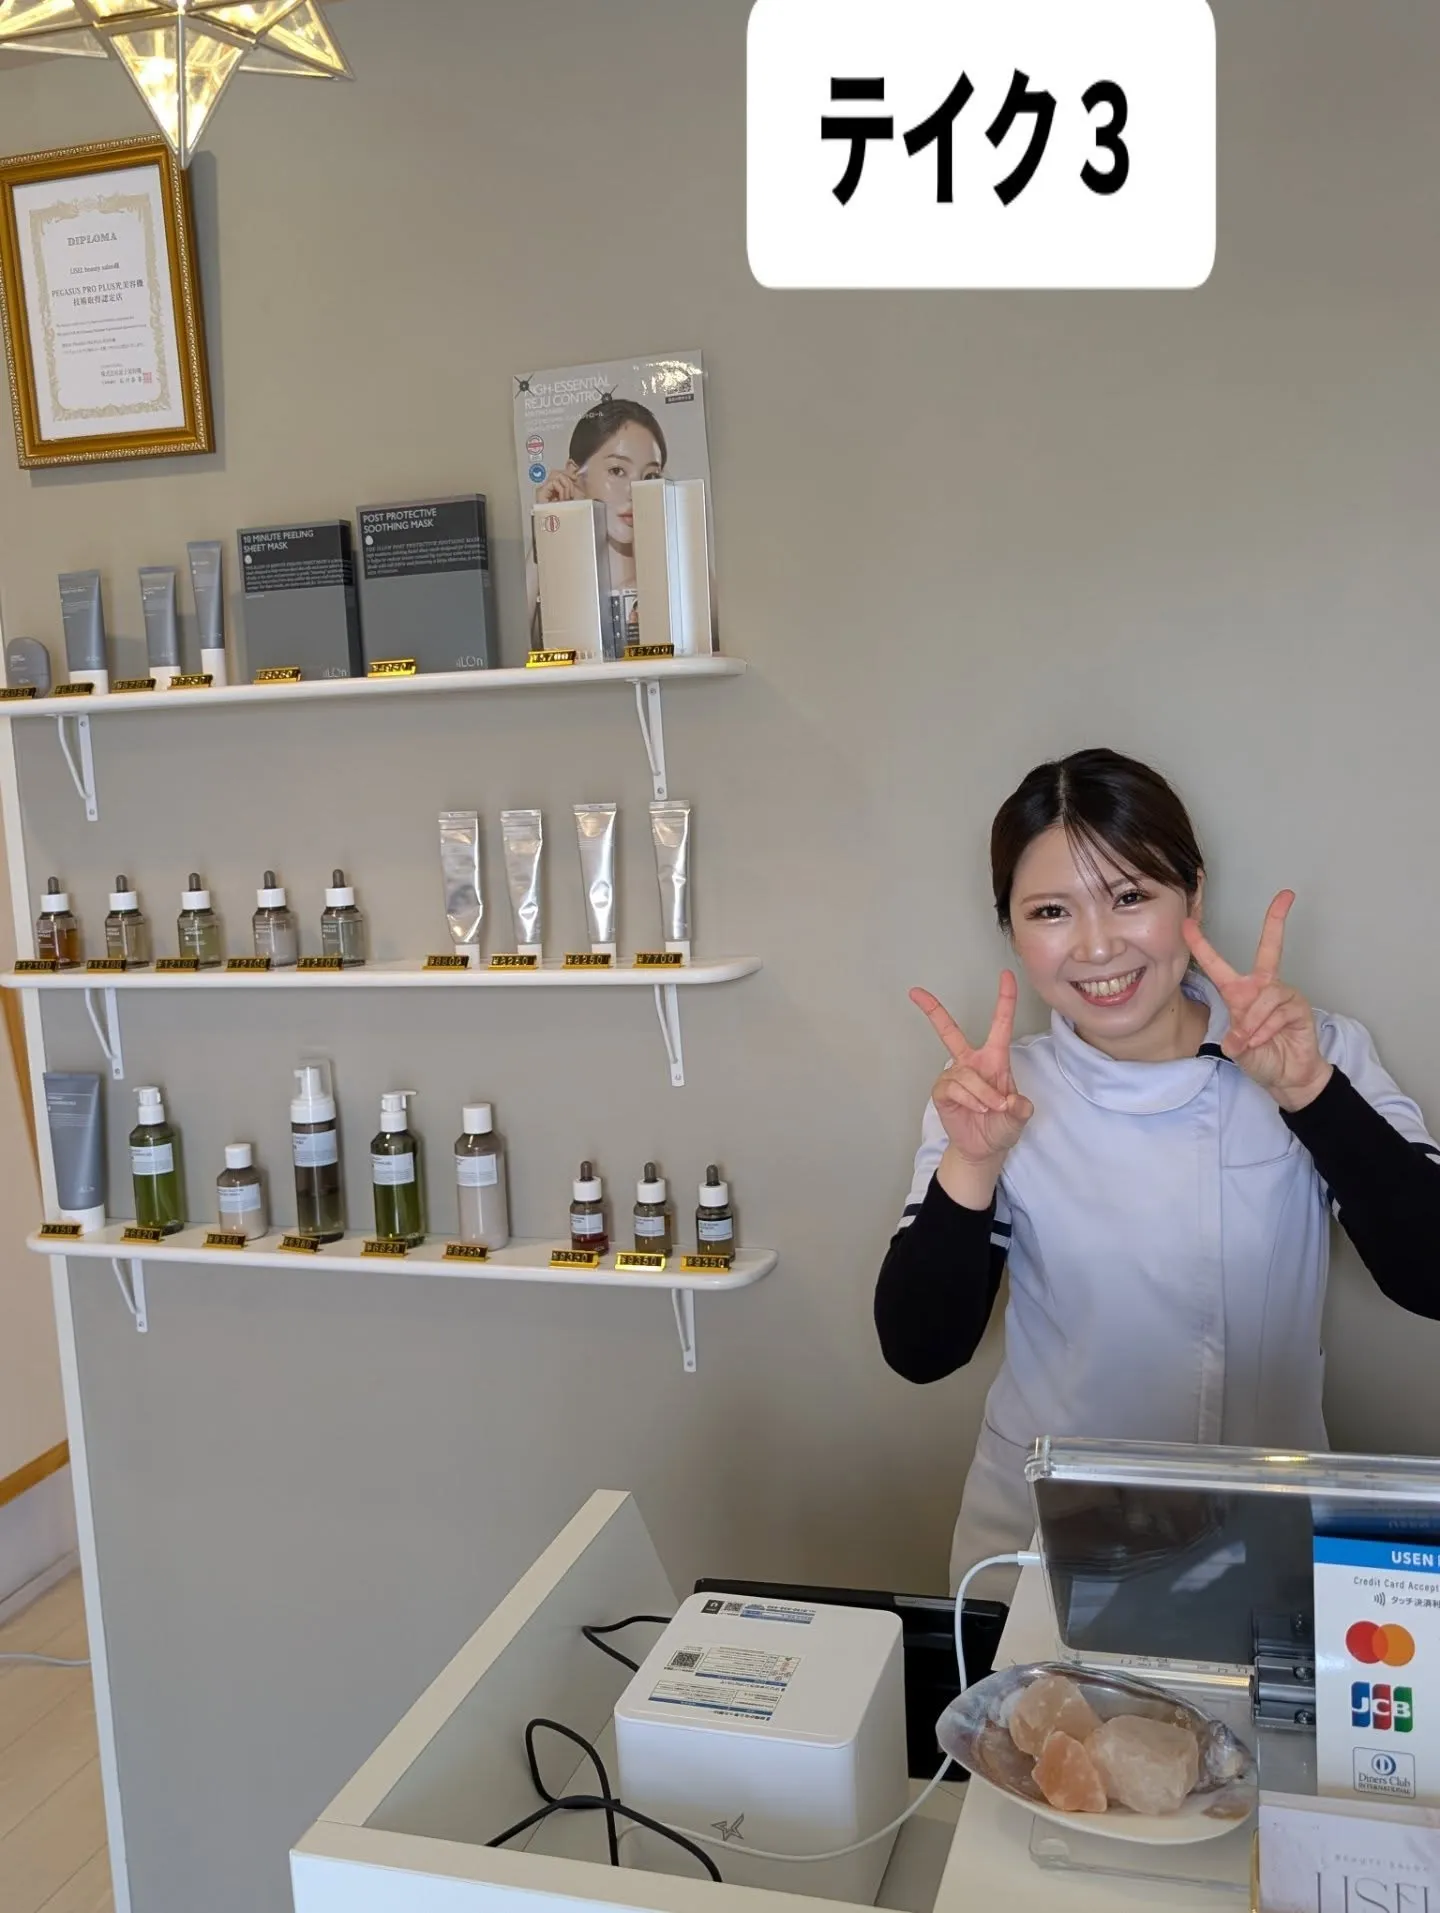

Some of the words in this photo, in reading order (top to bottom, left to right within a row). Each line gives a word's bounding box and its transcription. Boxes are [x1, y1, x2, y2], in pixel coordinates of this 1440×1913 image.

[67, 232, 117, 246] DIPLOMA
[51, 286, 82, 298] PEGASUS
[82, 284, 97, 294] PRO
[363, 513, 384, 523] POST
[385, 507, 437, 521] PROTECTIVE
[363, 521, 409, 534] SOOTHING
[410, 518, 434, 528] MASK
[252, 532, 282, 543] MINUTE
[283, 529, 314, 540] PEELING
[243, 543, 266, 553] SHEET
[267, 541, 288, 551] MASK
[638, 954, 674, 964] ¥7700
[1391, 1551, 1434, 1567] USEN
[1353, 1576, 1381, 1587] Credit
[1384, 1579, 1405, 1590] Card
[1358, 1772, 1387, 1785] Diners
[1389, 1776, 1411, 1787] Club
